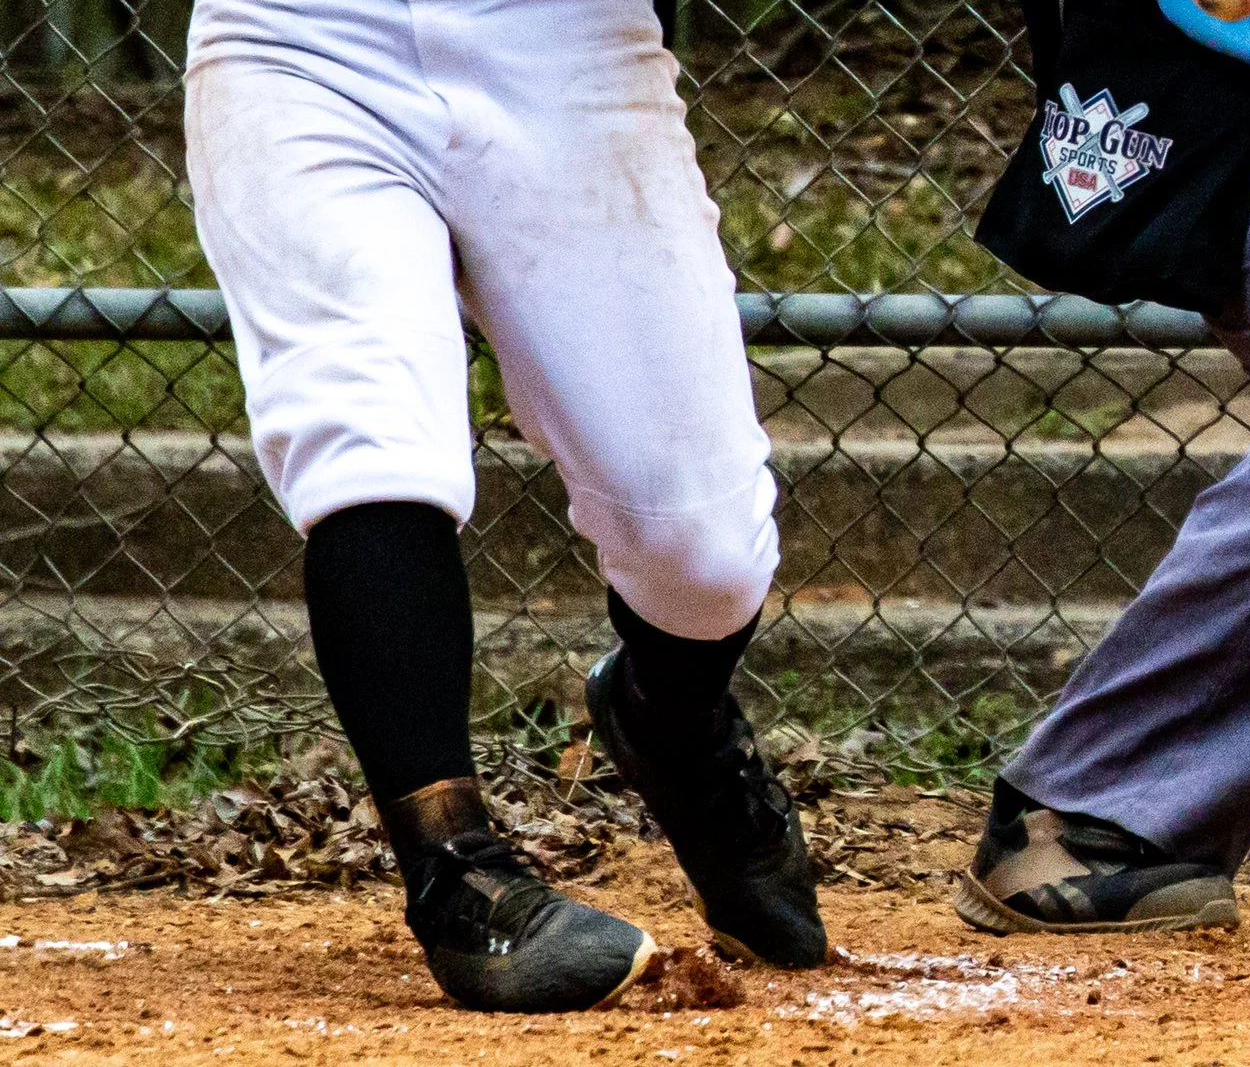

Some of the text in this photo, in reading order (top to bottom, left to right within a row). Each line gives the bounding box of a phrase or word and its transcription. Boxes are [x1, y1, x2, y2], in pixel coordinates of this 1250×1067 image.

[1042, 100, 1173, 169] TOP GUN
[1059, 147, 1118, 174] SPORTS
[1067, 169, 1099, 191] USA
